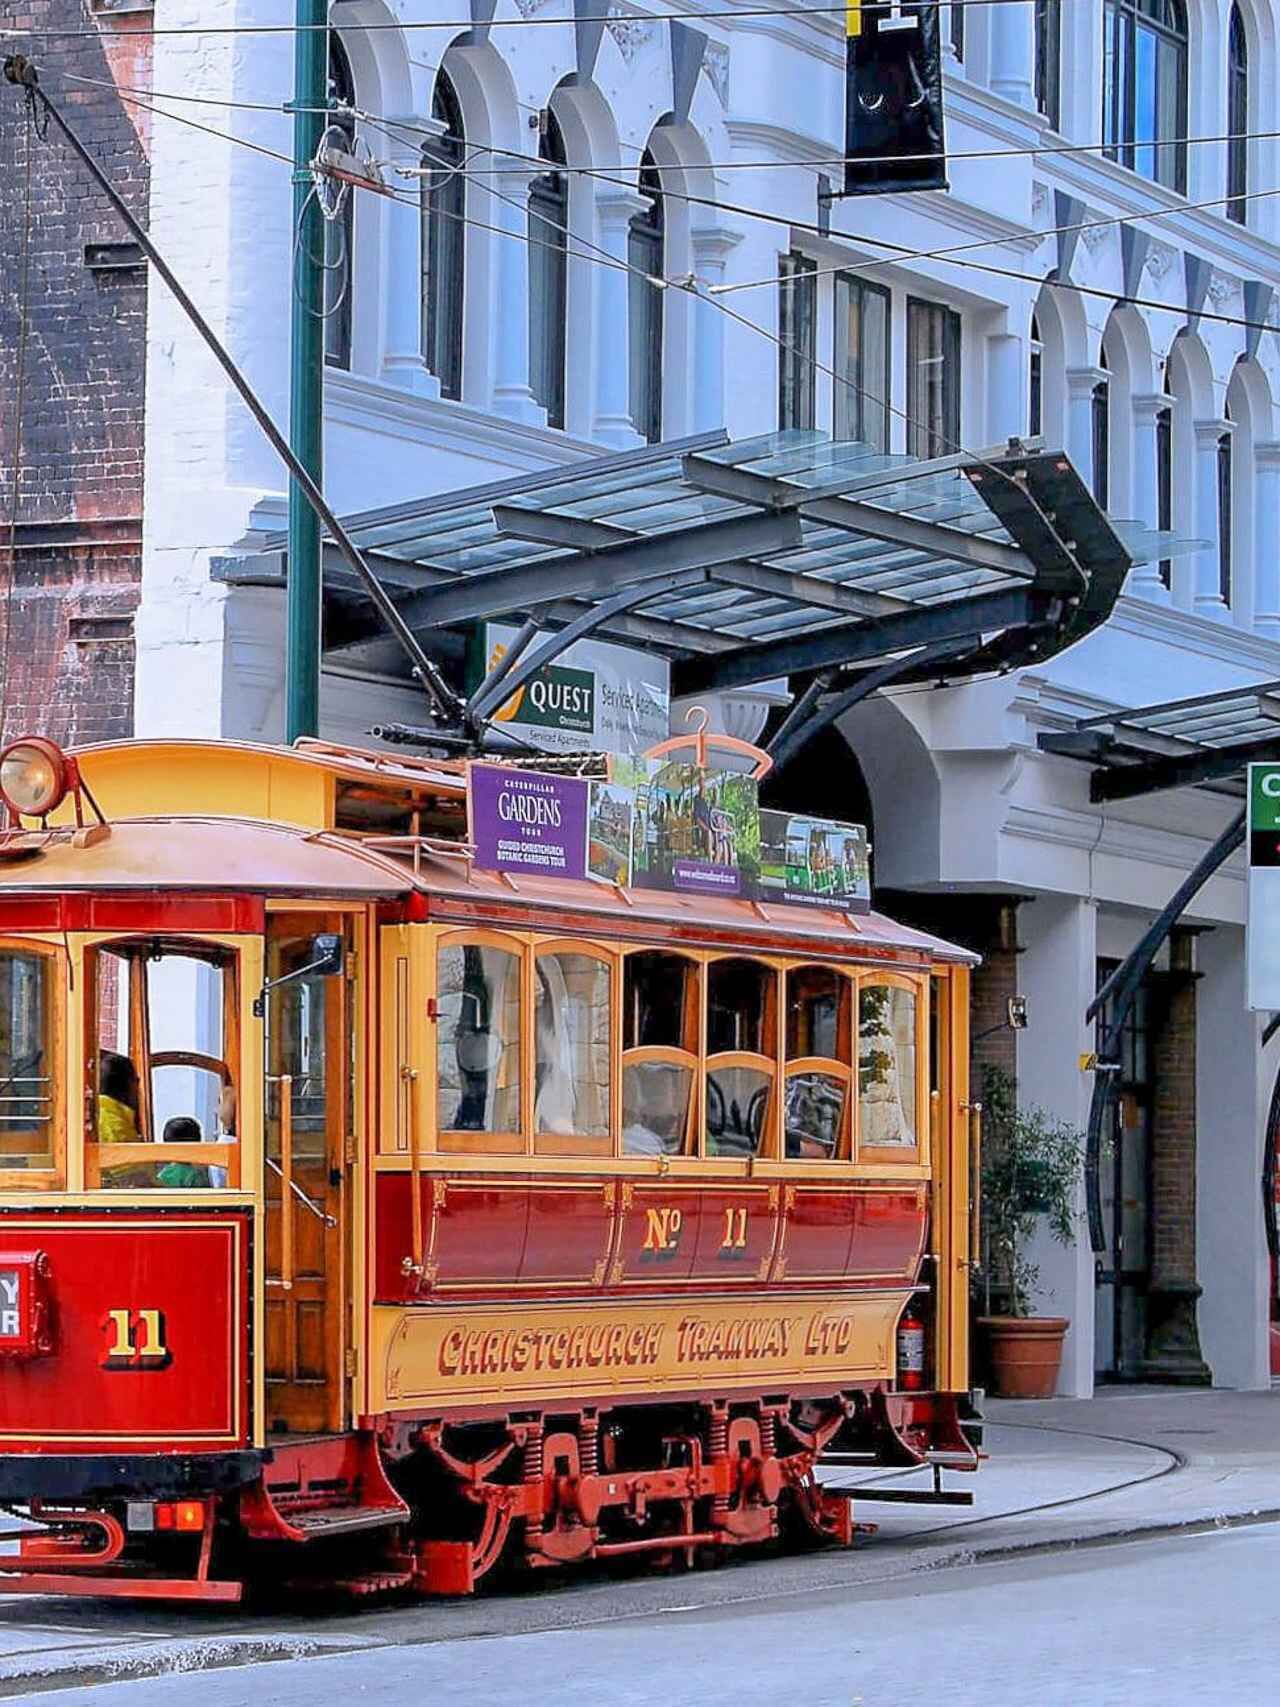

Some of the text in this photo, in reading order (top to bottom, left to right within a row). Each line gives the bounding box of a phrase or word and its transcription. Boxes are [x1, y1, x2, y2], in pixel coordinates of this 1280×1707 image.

[530, 680, 592, 714] QUEST
[498, 792, 561, 827] GARDENS
[722, 1208, 748, 1248] 11
[107, 1309, 168, 1357] 11
[438, 1312, 855, 1376] CHRISTCHURCH TRAMWAY LTD
